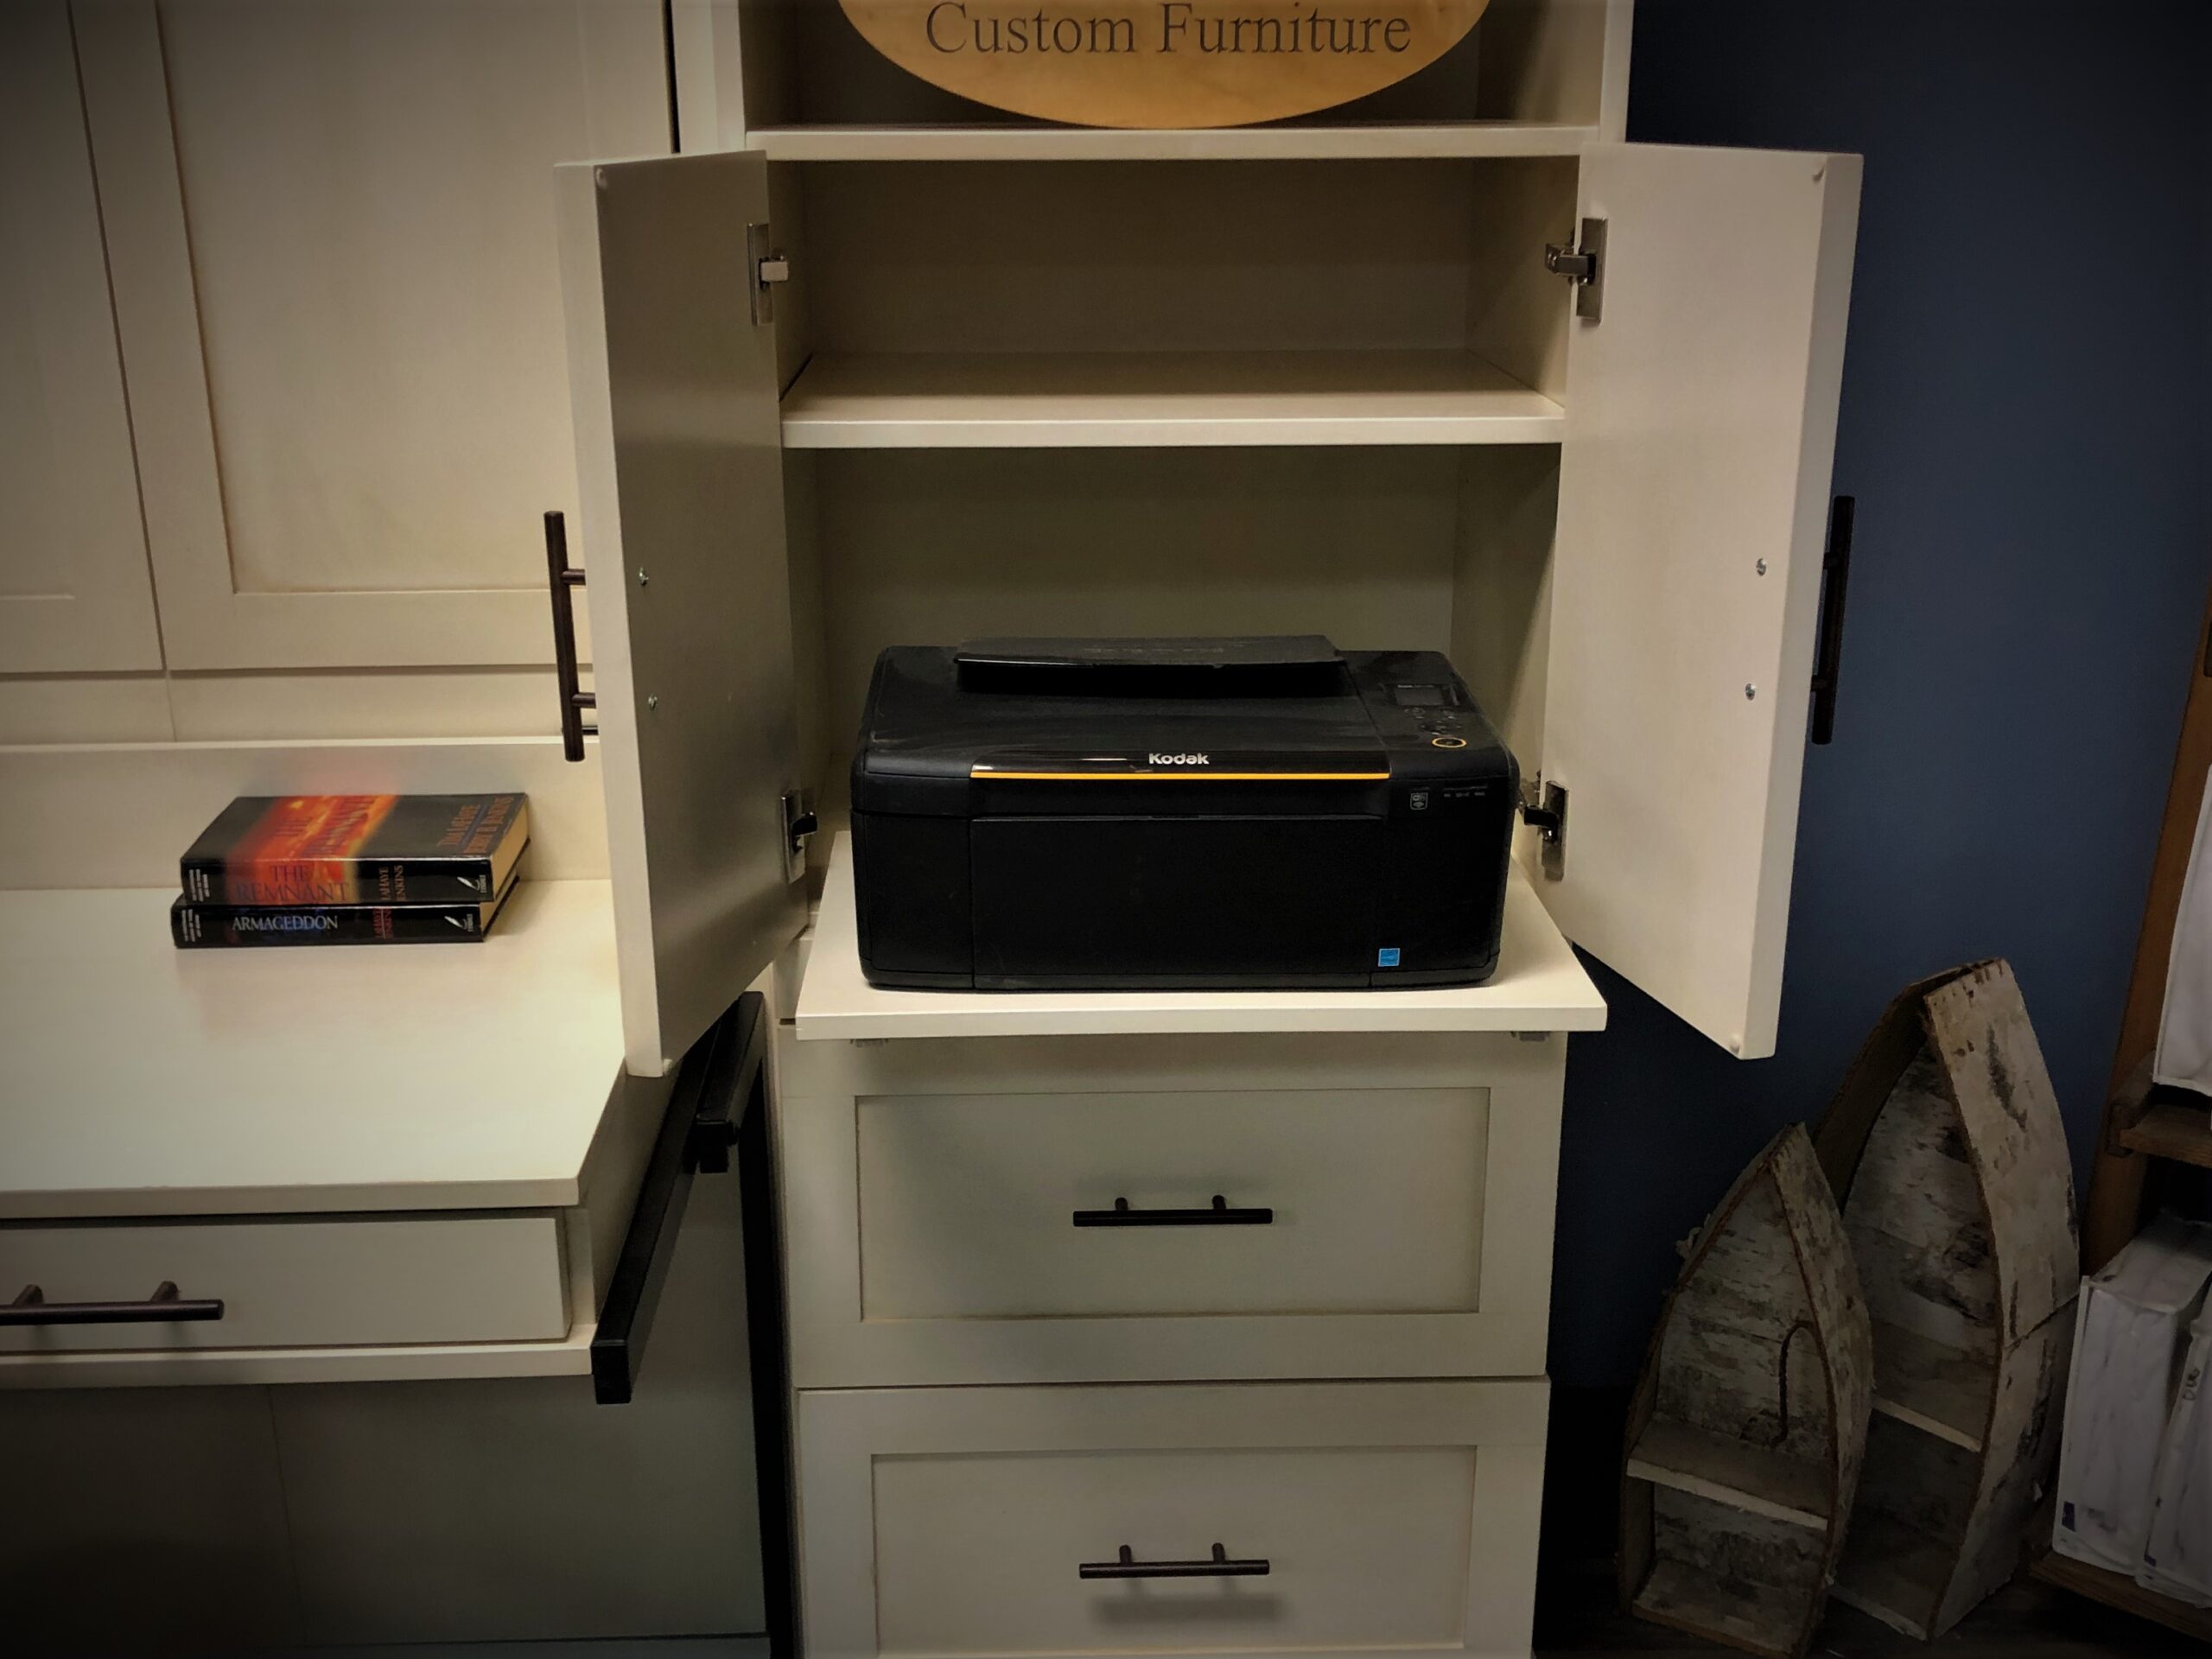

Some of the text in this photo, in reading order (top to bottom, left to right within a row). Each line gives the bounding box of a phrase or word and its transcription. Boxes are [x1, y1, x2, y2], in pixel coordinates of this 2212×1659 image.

[925, 2, 1412, 54] Custom Furniture
[1148, 753, 1210, 766] Kodak
[270, 865, 309, 882] THE
[234, 882, 350, 901] REMNANT
[232, 915, 339, 931] ARMAGEDDON
